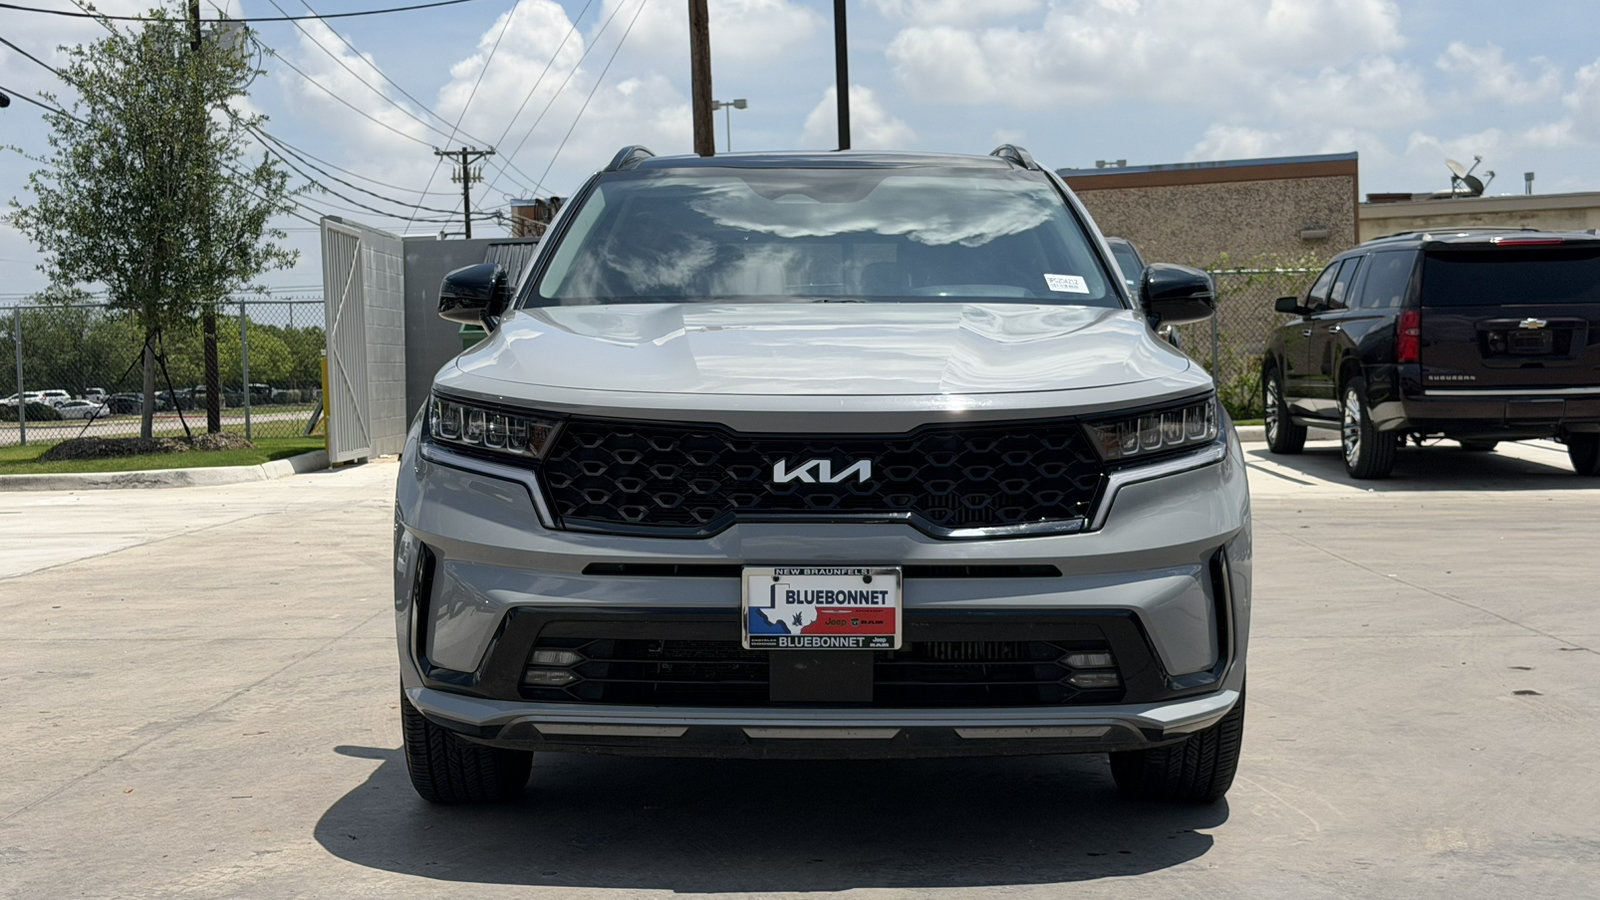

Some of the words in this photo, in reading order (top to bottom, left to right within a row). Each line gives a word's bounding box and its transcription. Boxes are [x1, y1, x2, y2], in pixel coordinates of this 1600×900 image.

[773, 459, 872, 483] KIA
[786, 590, 888, 605] BLUEBONNET
[825, 617, 847, 626] Jeep
[779, 637, 865, 647] BLUEBONNET
